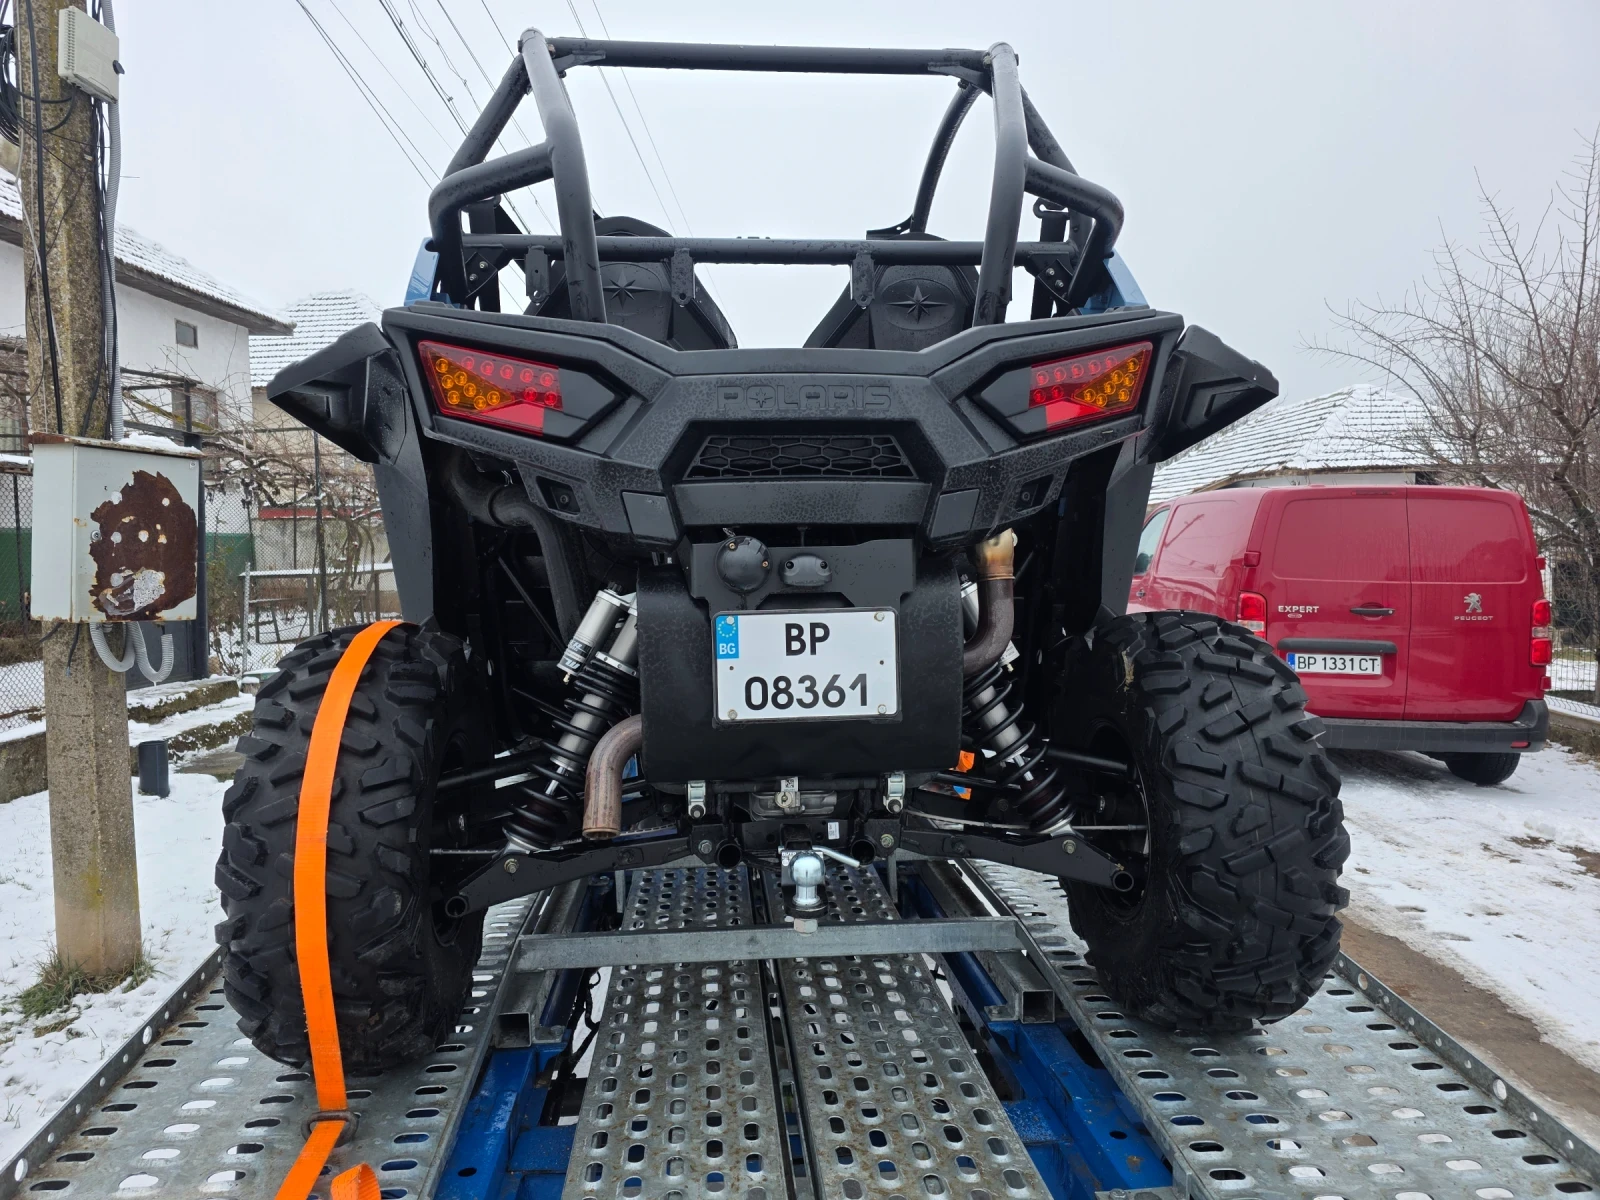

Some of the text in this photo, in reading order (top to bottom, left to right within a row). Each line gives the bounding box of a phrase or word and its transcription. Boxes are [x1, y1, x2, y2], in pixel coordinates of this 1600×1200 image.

[717, 385, 892, 411] POLARIS
[1278, 605, 1319, 613] EXPERT
[719, 643, 736, 655] BG
[785, 622, 831, 657] BP
[1297, 656, 1317, 670] BP
[1321, 656, 1355, 671] 1331
[1358, 658, 1378, 672] CT
[744, 673, 868, 711] 08361
